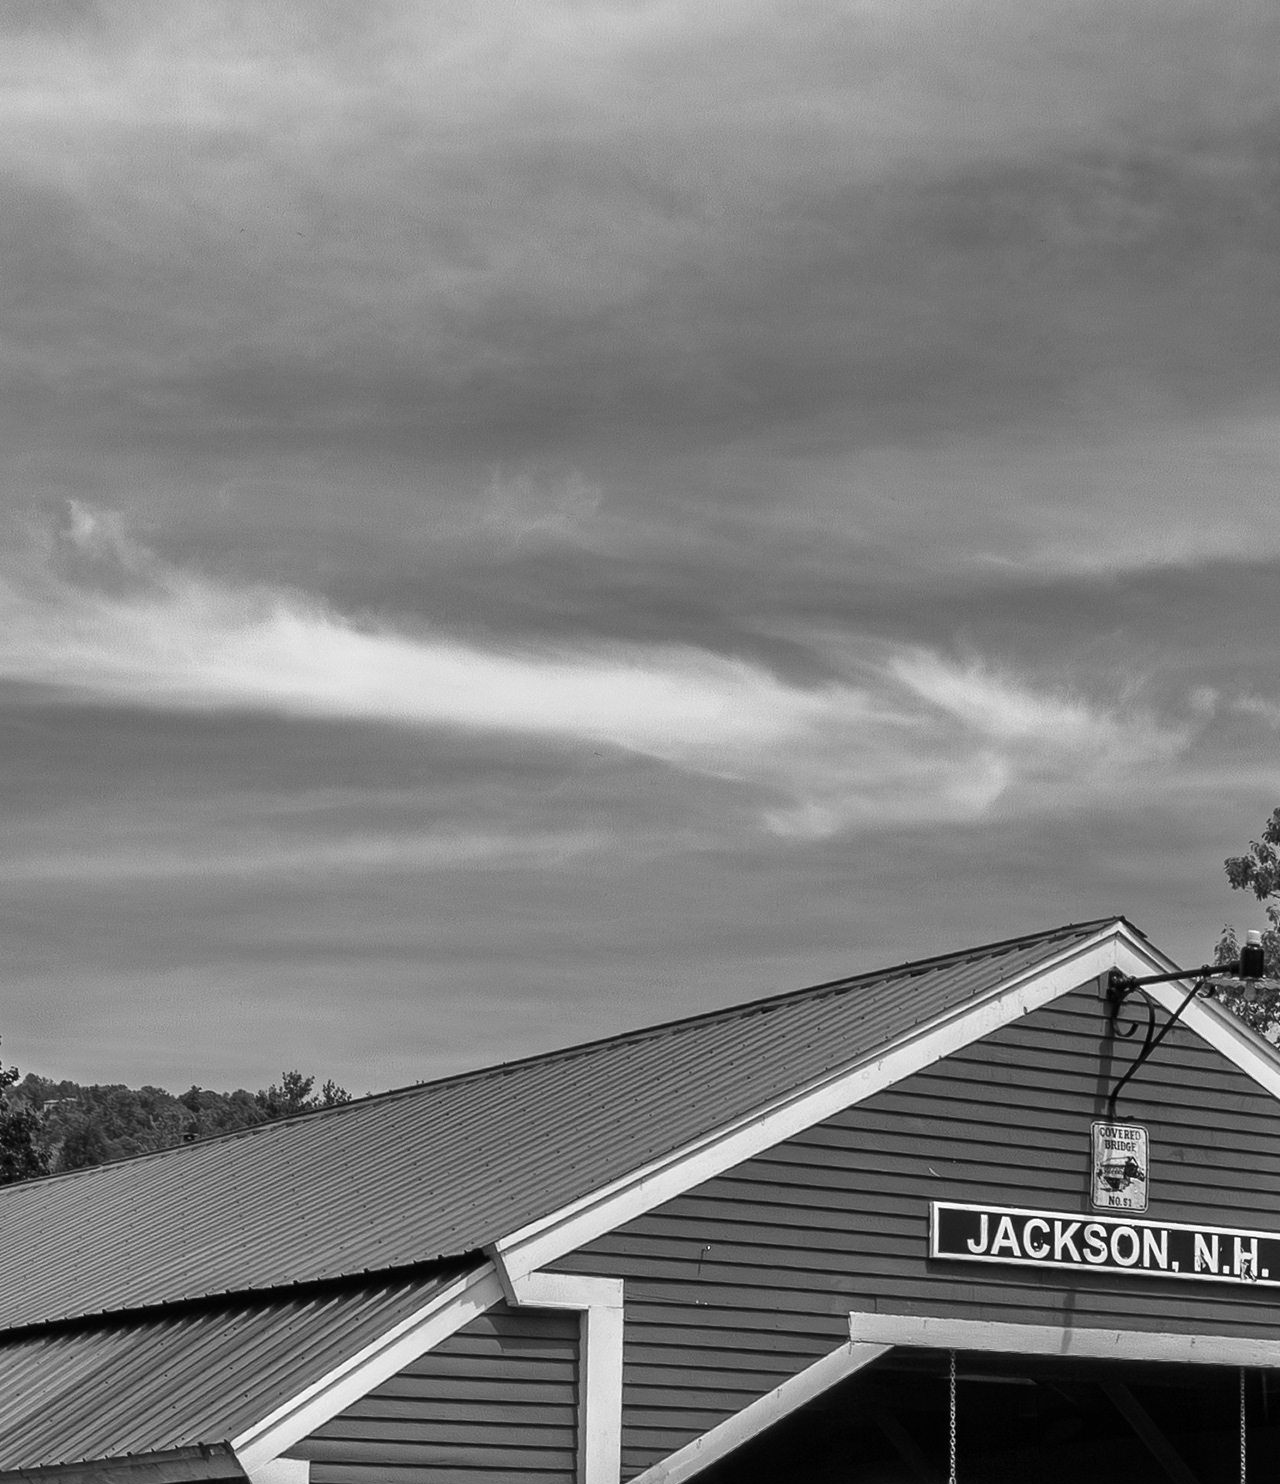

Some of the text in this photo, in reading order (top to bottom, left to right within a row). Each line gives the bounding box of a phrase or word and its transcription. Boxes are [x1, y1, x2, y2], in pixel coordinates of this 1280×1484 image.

[1100, 1127, 1142, 1141] COVERED
[1104, 1139, 1137, 1152] BRIDGE
[966, 1213, 1270, 1279] JACKSON, N.H.
